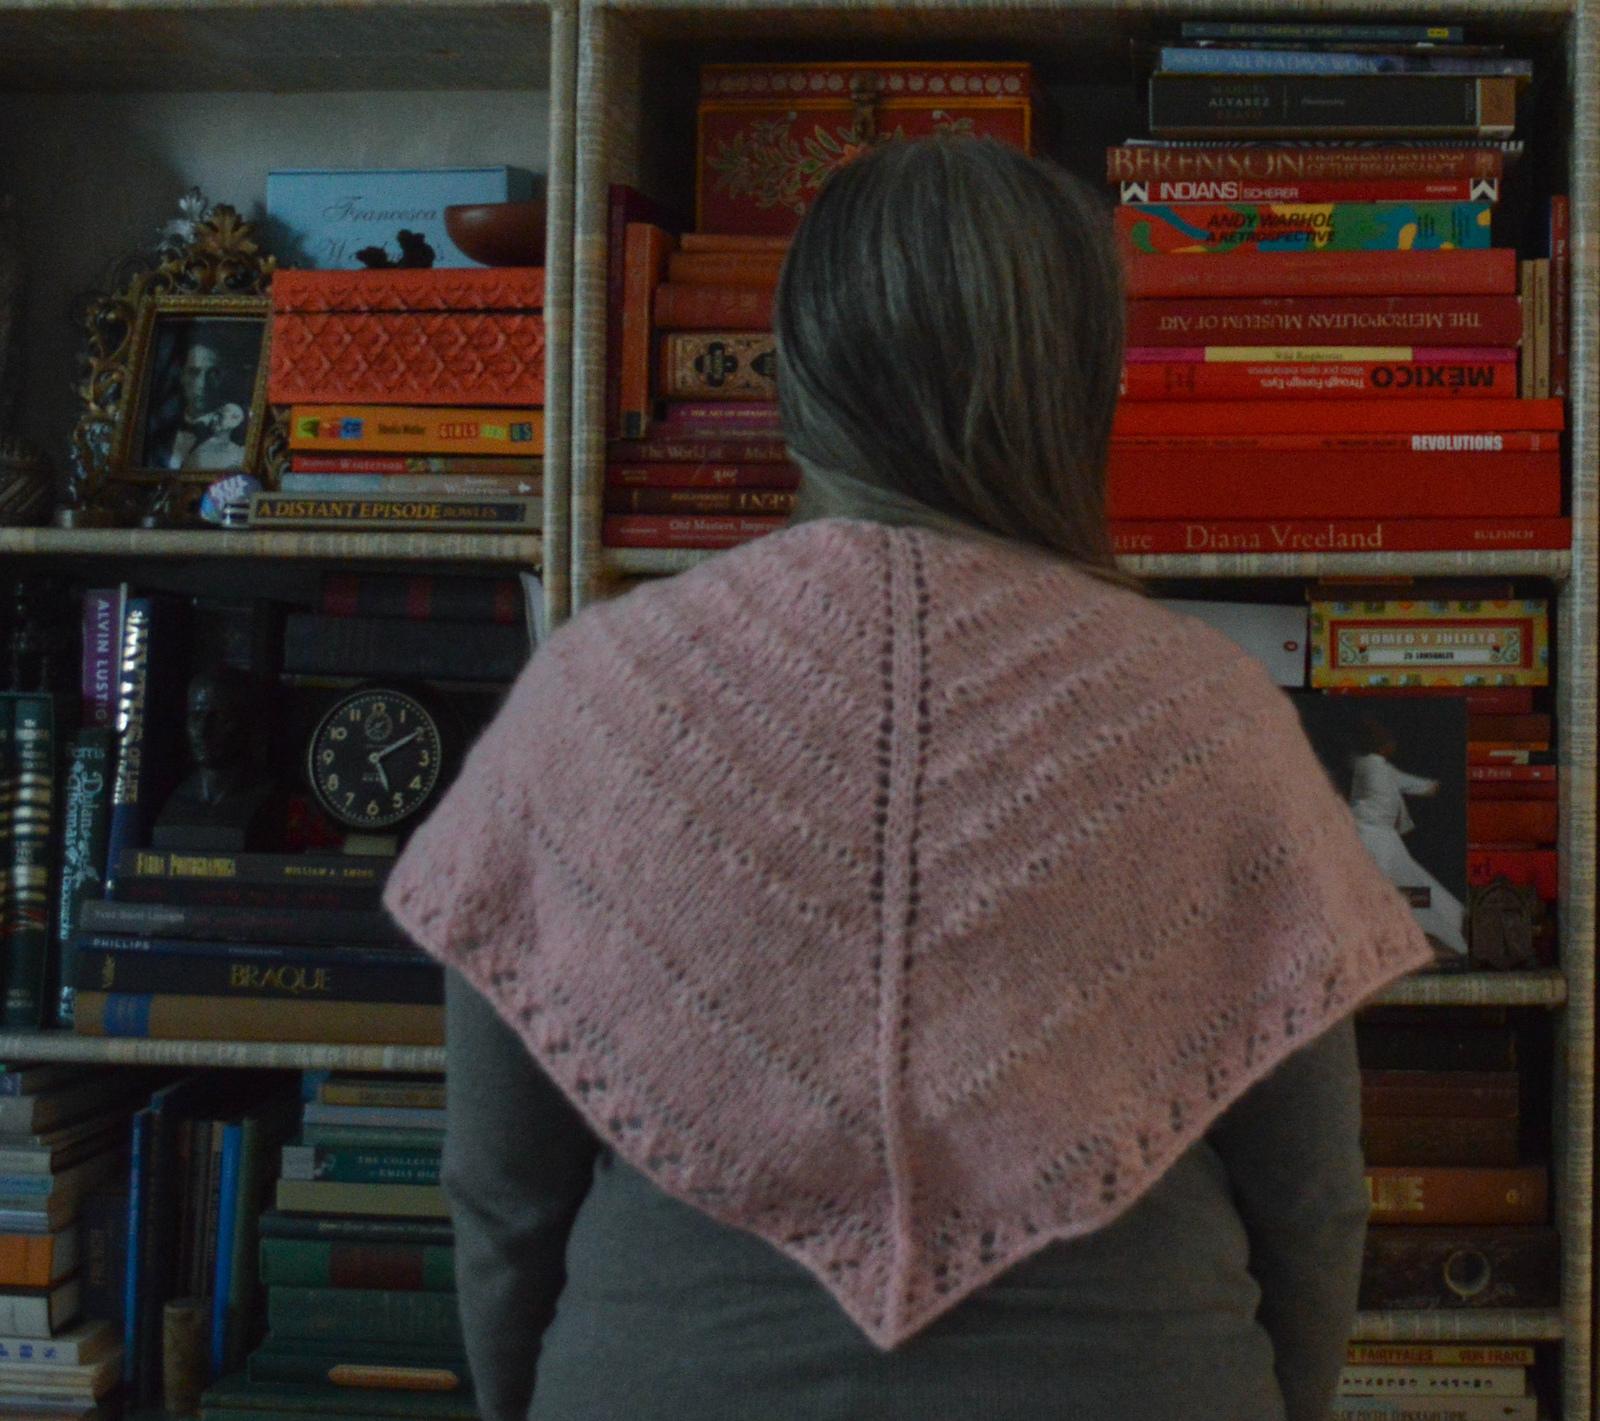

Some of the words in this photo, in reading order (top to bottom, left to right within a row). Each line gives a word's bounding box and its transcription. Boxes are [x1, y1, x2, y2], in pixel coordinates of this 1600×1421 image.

[1208, 97, 1270, 107] ALVAREZ
[1114, 149, 1305, 177] BERENSON
[1159, 181, 1239, 200] INDIANS
[1243, 187, 1300, 199] SCHERER
[322, 196, 437, 221] Francesca
[1208, 213, 1257, 228] ANDY
[1261, 212, 1336, 228] WARHOL
[1206, 231, 1218, 242] A
[1158, 314, 1192, 331] ART
[1195, 314, 1220, 330] OF
[1223, 312, 1303, 330] MUSEUM
[1308, 311, 1443, 329] METROPOLITAN
[1448, 311, 1482, 326] THE
[1371, 366, 1495, 393] MÉXICO
[440, 424, 477, 438] GIRLS
[512, 425, 531, 440] US
[1411, 435, 1503, 451] REVOLUTIONS
[340, 458, 403, 471] Winterson
[740, 492, 795, 509] GENT
[258, 501, 272, 517] A
[275, 501, 355, 519] DISTANT
[359, 502, 441, 520] EPISODE
[669, 519, 691, 530] Old
[1184, 525, 1262, 550] Diana
[1271, 524, 1383, 550] Vreeland
[96, 600, 110, 652] ALVIN
[1359, 632, 1415, 645] ROMEO
[1421, 632, 1429, 645] Y
[1436, 632, 1498, 645] JULIETA
[94, 659, 109, 720] LUSTIG
[350, 709, 361, 722] 11
[400, 708, 407, 724] 1
[329, 726, 348, 742] 10
[322, 748, 335, 767] 9
[418, 749, 431, 768] 3
[327, 773, 340, 792] 8
[409, 774, 423, 790] 4
[77, 772, 103, 829] Dylan
[344, 791, 356, 806] 7
[392, 791, 404, 809] 5
[63, 773, 81, 847] Thomas
[366, 800, 380, 817] 6
[93, 938, 150, 950] PHILLIPS
[229, 963, 331, 993] BRAQUE
[383, 1156, 441, 1167] COLLECT
